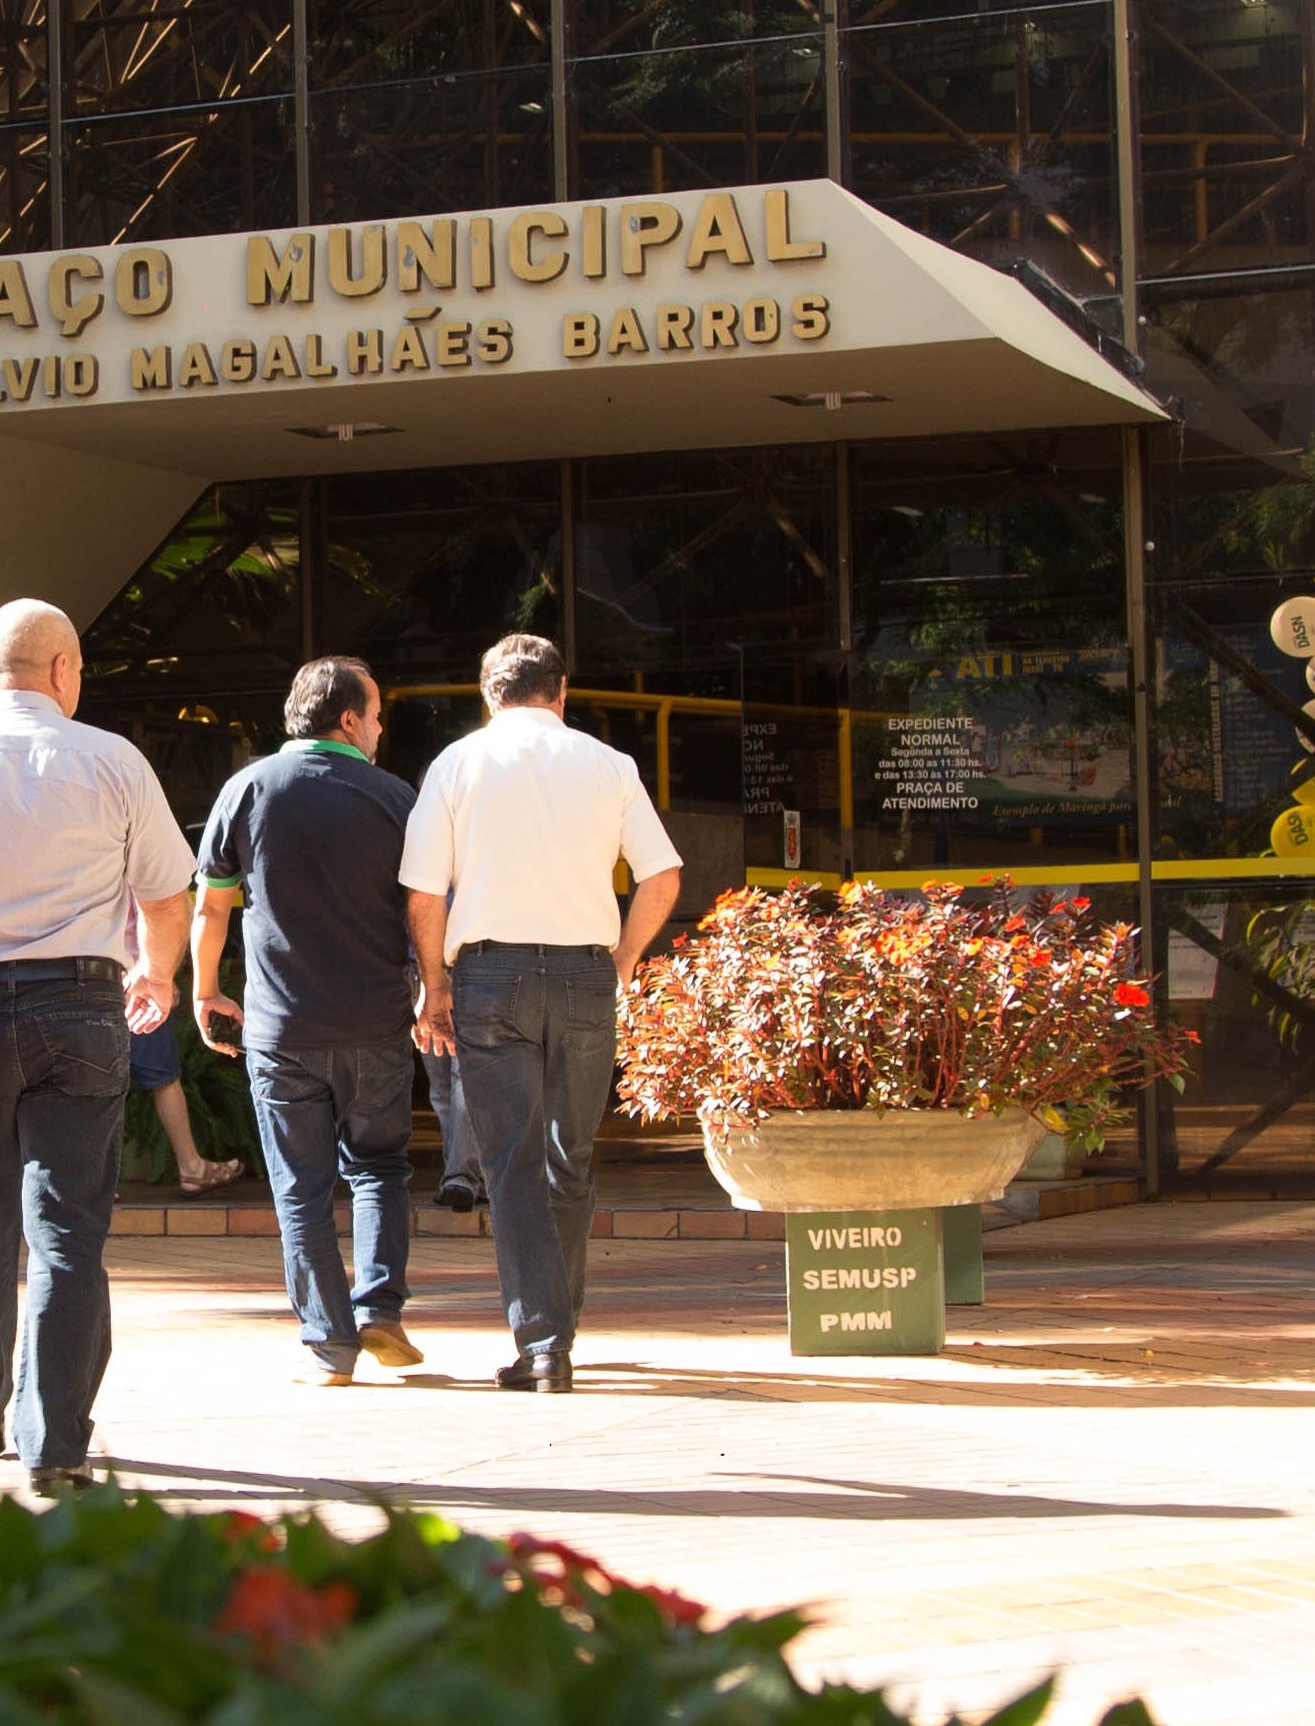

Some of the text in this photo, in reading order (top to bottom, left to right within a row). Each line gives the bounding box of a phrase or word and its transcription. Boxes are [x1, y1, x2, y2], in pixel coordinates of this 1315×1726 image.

[245, 187, 829, 307] MUNICIPAL
[130, 305, 515, 393] MAGALHÃES
[561, 293, 833, 359] BARROS
[1291, 615, 1310, 649] DASN
[956, 651, 1013, 679] ATI
[888, 717, 974, 731] EXPEDIENTE
[901, 733, 961, 746] NORMAL
[890, 747, 933, 758] Segunda
[942, 746, 970, 756] Sexta
[878, 759, 896, 768] das
[898, 758, 925, 768] 08:00
[940, 757, 966, 767] 11:30
[968, 757, 982, 767] hs.
[874, 771, 881, 779] e
[882, 770, 900, 779] das
[903, 770, 929, 779] 13:30
[944, 769, 970, 778] 17:00
[972, 769, 986, 778] hs.
[896, 782, 964, 796] PRAÇA DE
[882, 796, 979, 810] ATENDIMENTO
[992, 802, 1040, 818] Exemplo
[1041, 802, 1055, 814] de
[807, 1226, 903, 1251] VIVEIRO
[802, 1267, 917, 1291] SEMUSP
[820, 1310, 893, 1333] PMM
